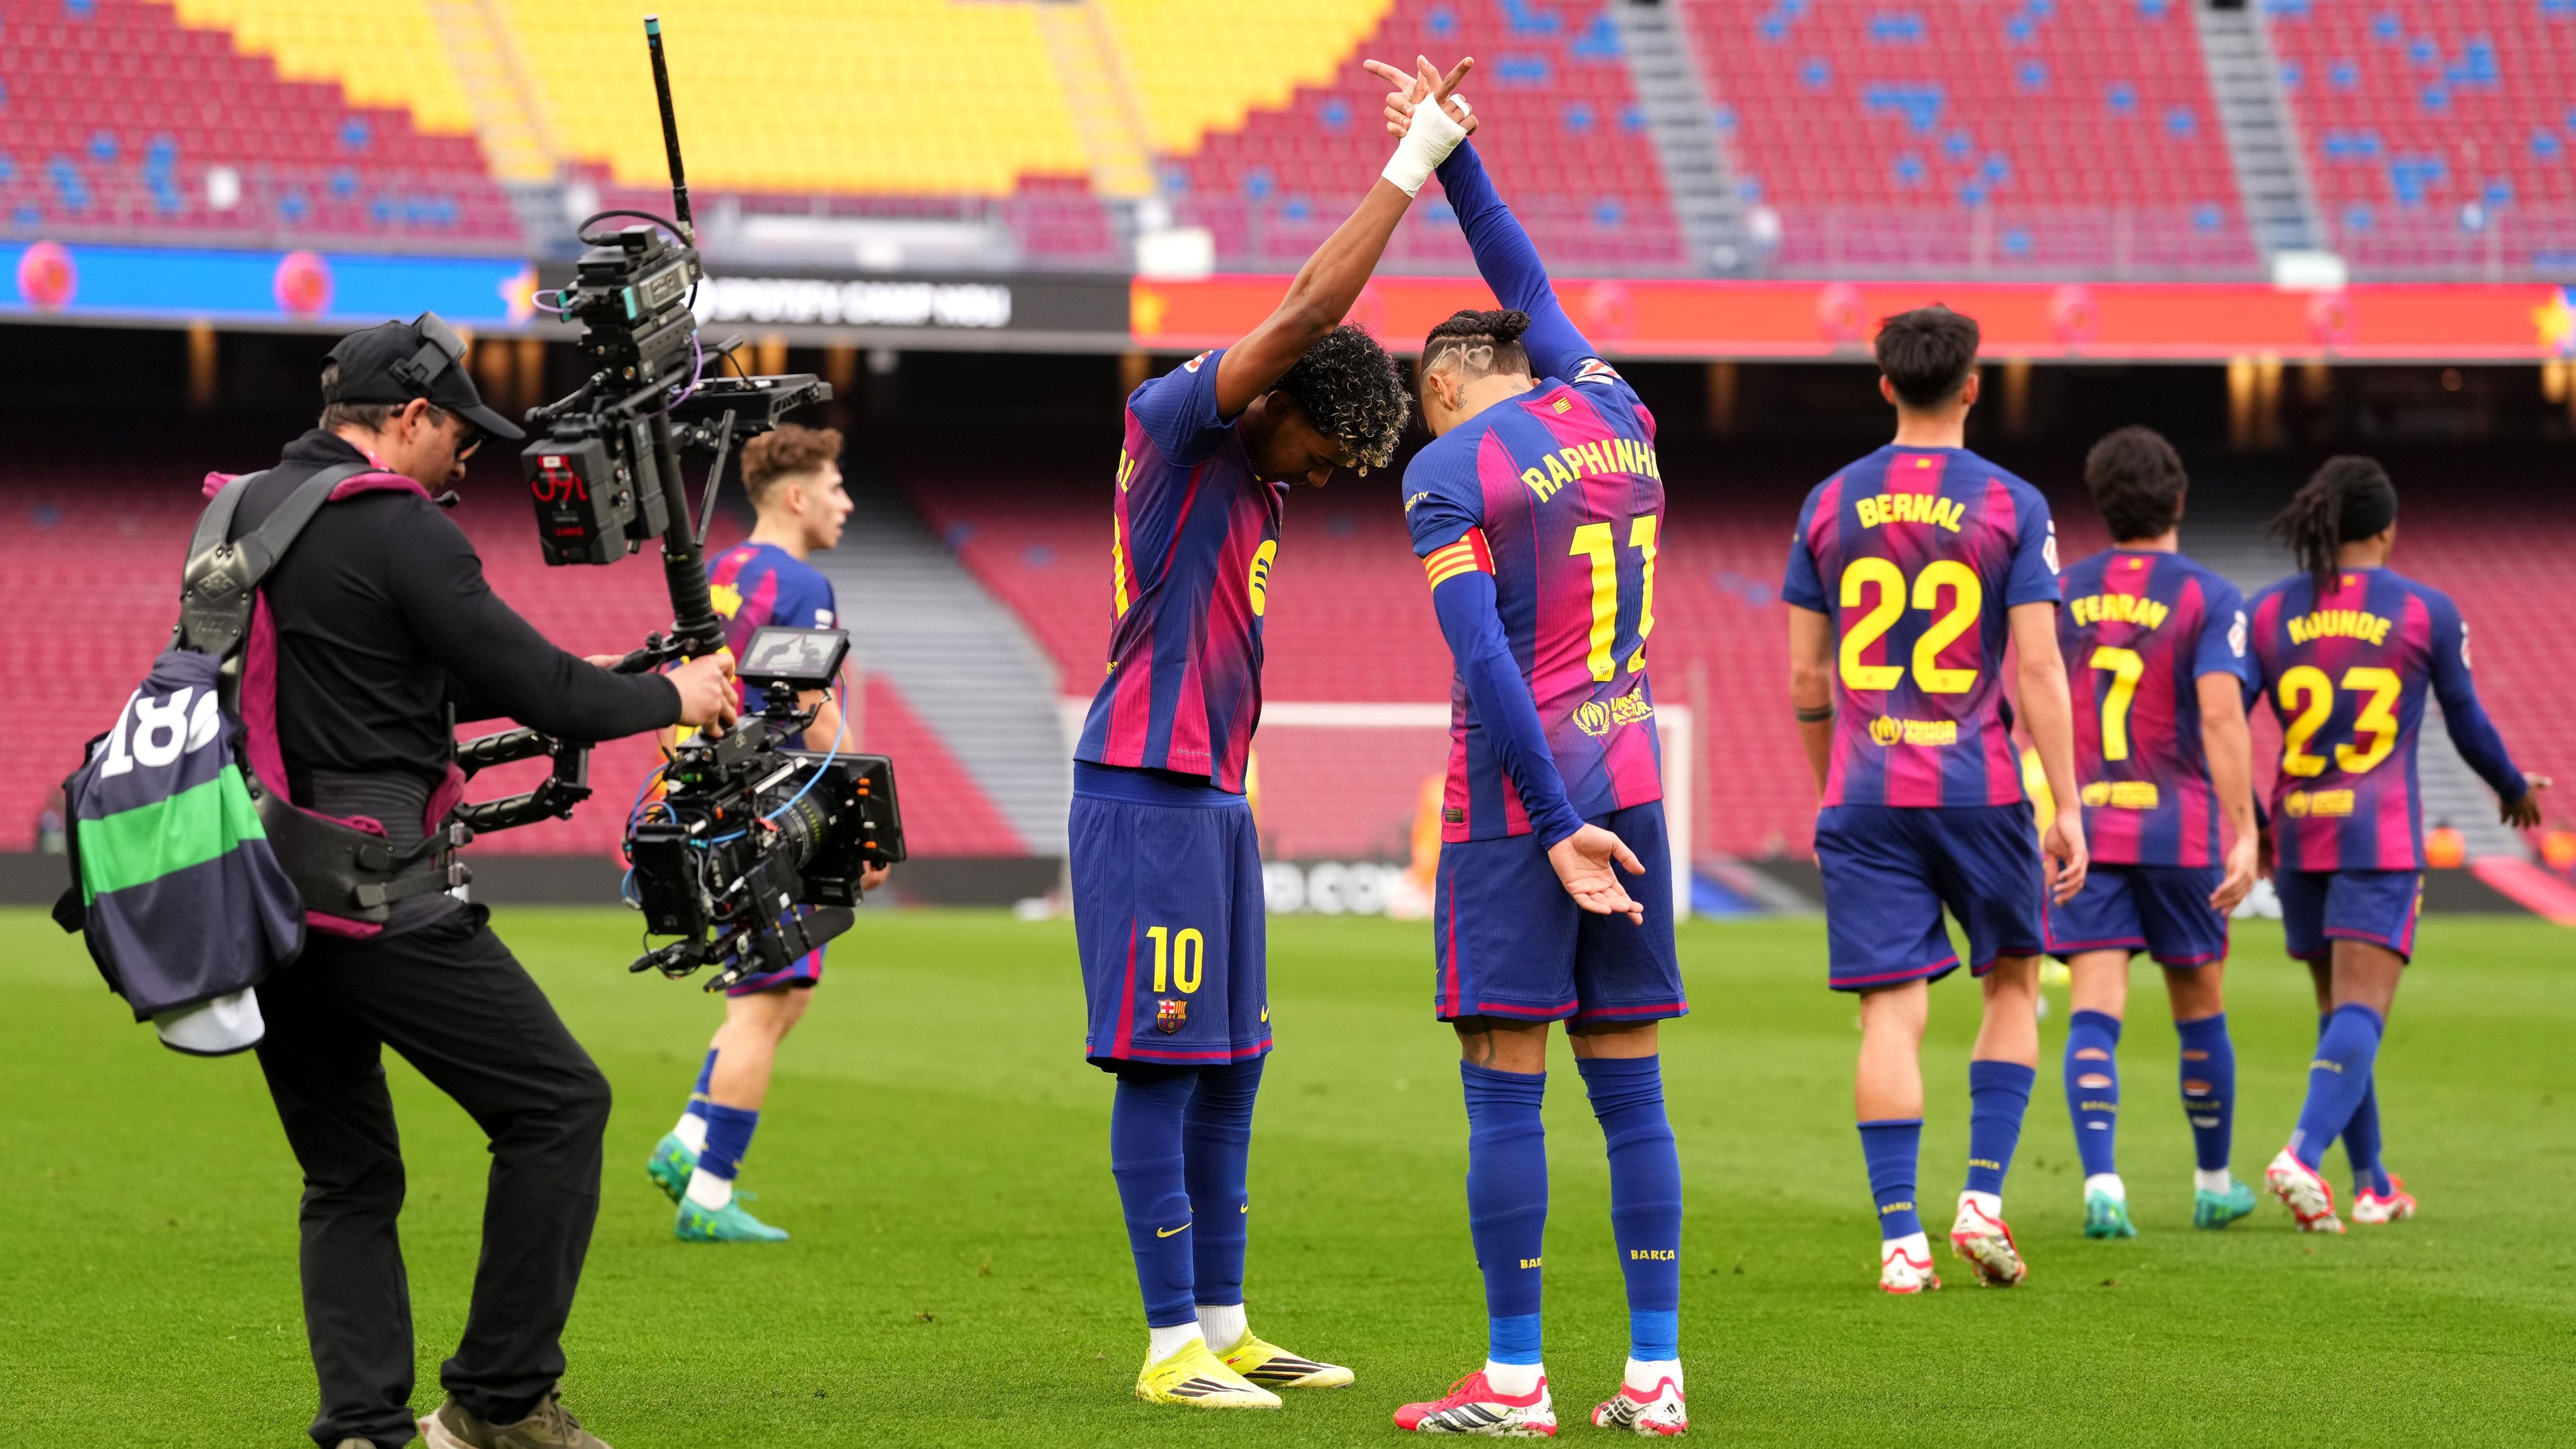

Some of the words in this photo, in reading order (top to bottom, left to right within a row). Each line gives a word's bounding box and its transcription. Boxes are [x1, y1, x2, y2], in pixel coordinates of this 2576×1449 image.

[1418, 491, 1429, 500] tv
[1856, 493, 1966, 533] BERNAL
[1568, 513, 1658, 683] 11
[1839, 556, 1982, 694] 22
[2069, 593, 2169, 631] FERRAN
[2088, 645, 2145, 761] 7
[2278, 665, 2403, 777] 23
[1146, 926, 1204, 993] 10
[1631, 1249, 1675, 1261] BARÇA
